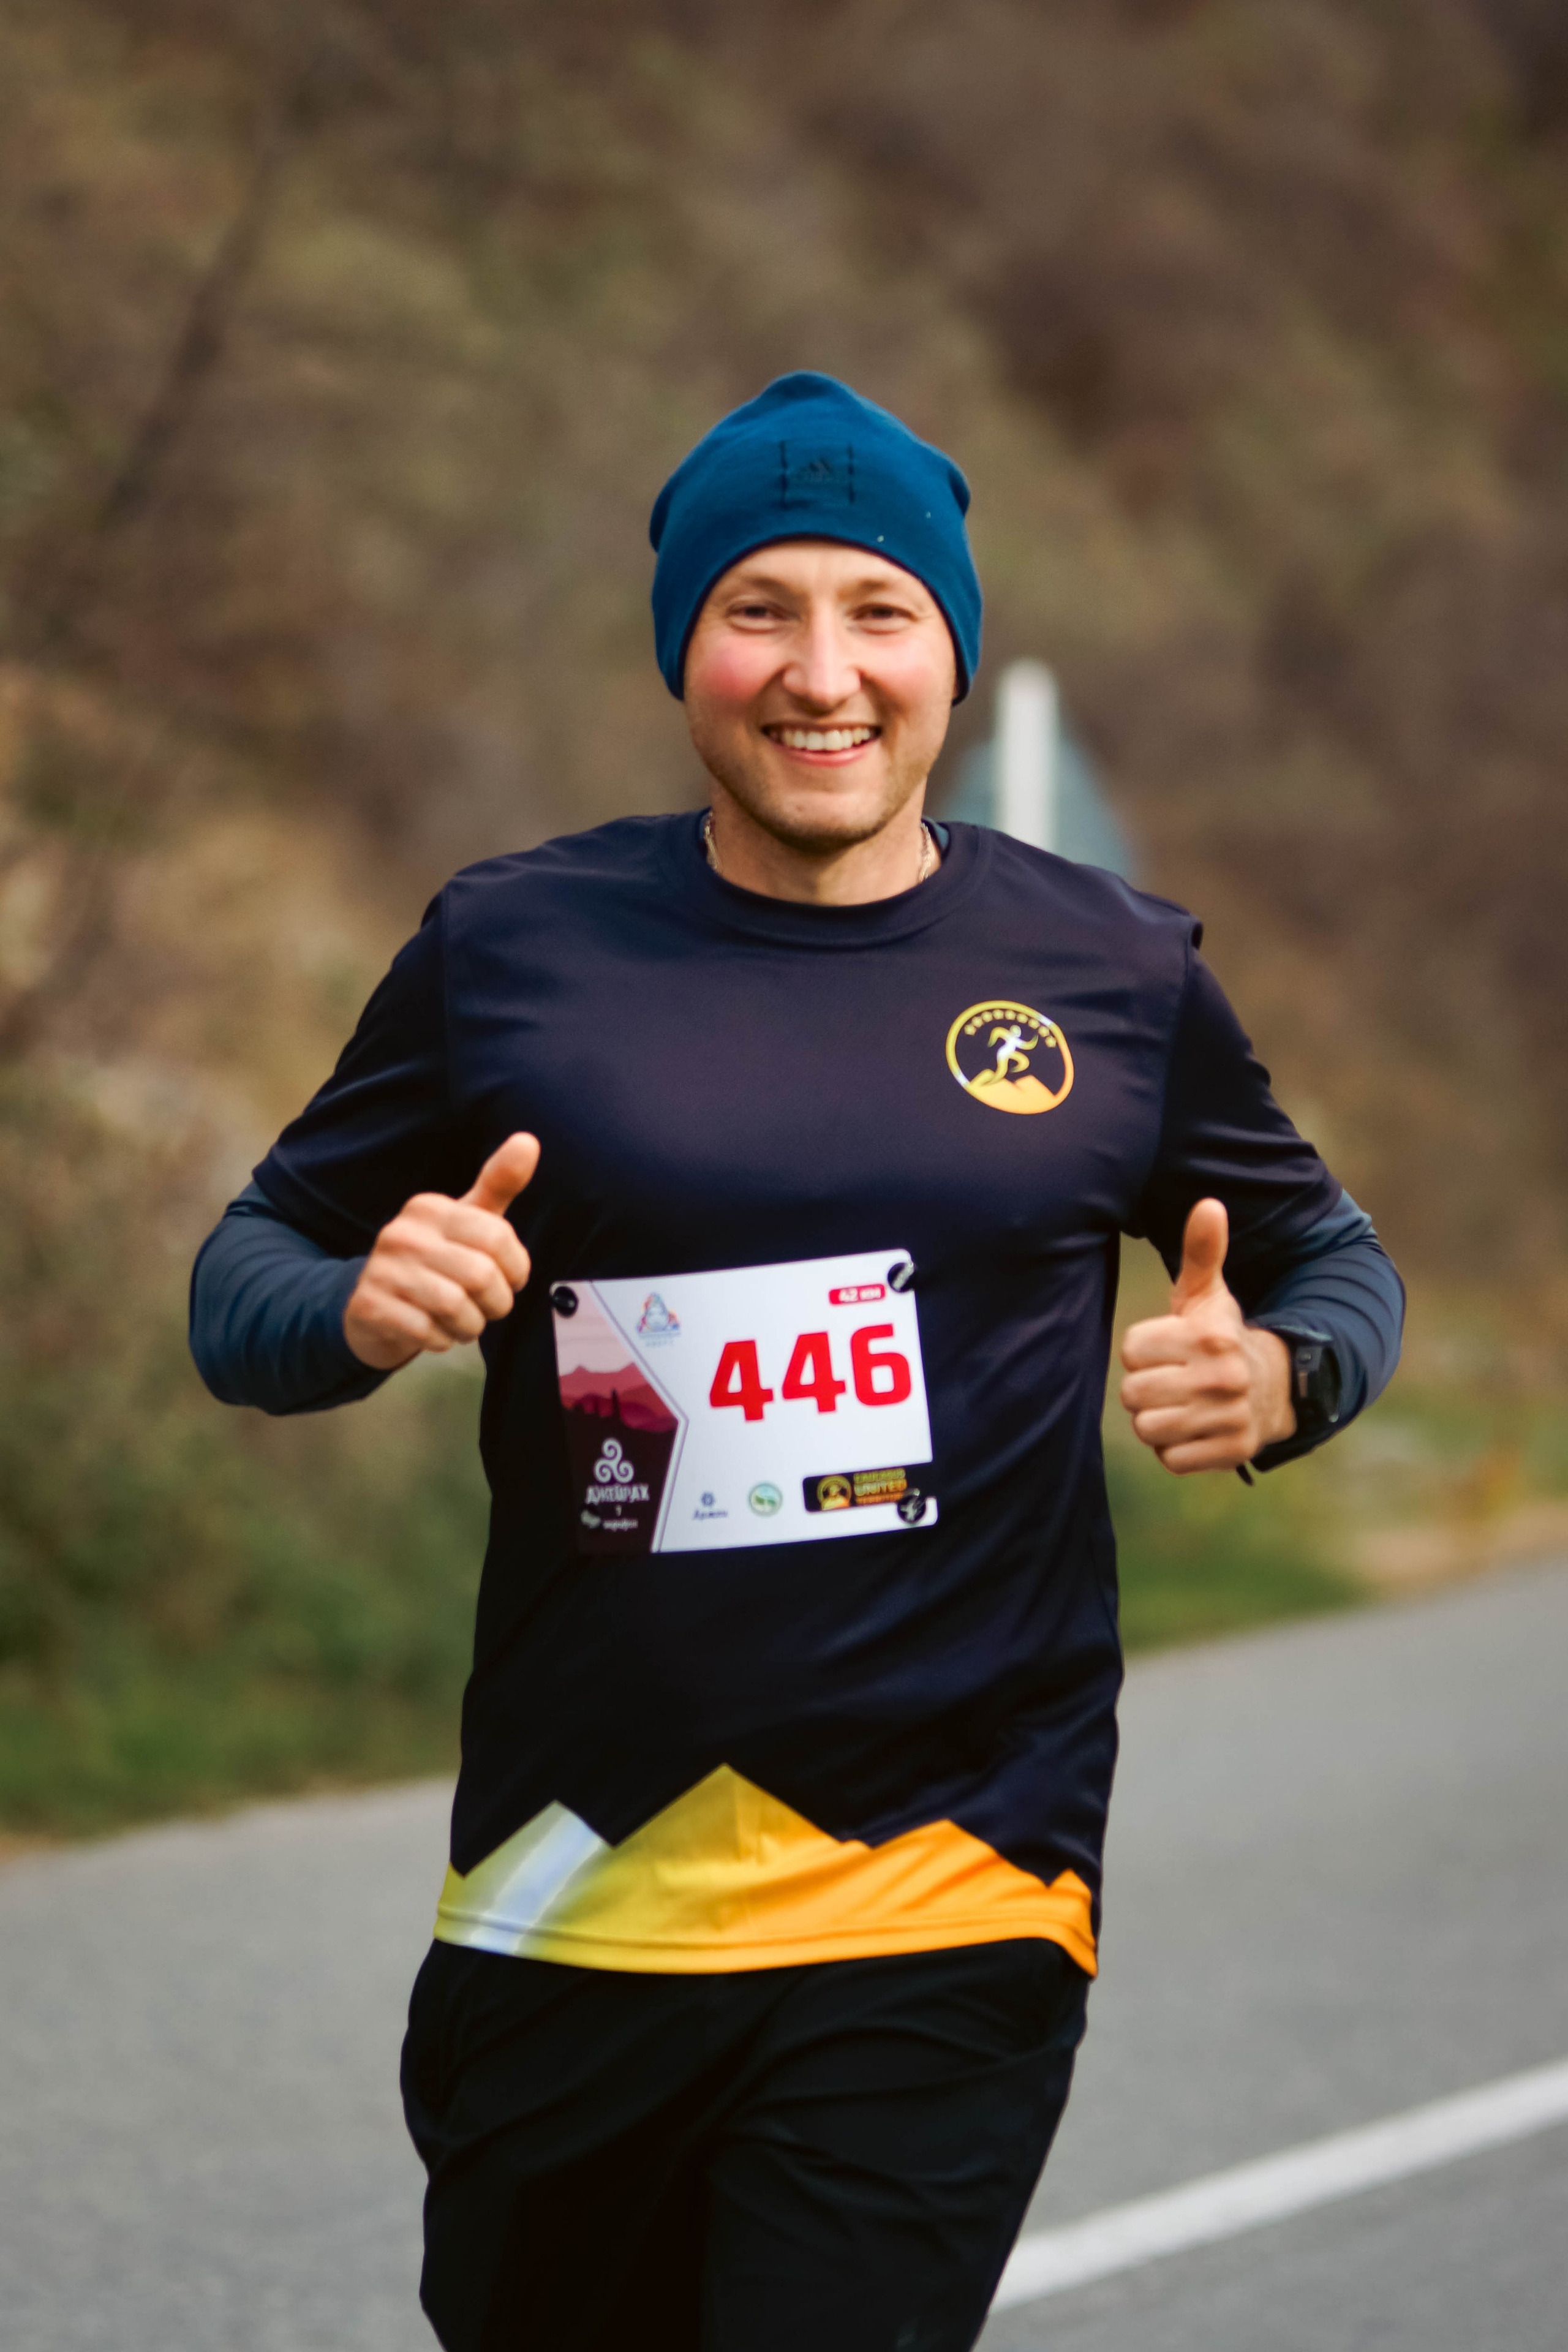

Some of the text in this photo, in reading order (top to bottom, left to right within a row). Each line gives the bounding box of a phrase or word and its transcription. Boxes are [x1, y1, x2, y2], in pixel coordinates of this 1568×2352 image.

[839, 1287, 858, 1302] 42
[709, 1324, 911, 1421] 446
[854, 1478, 908, 1496] UNITED
